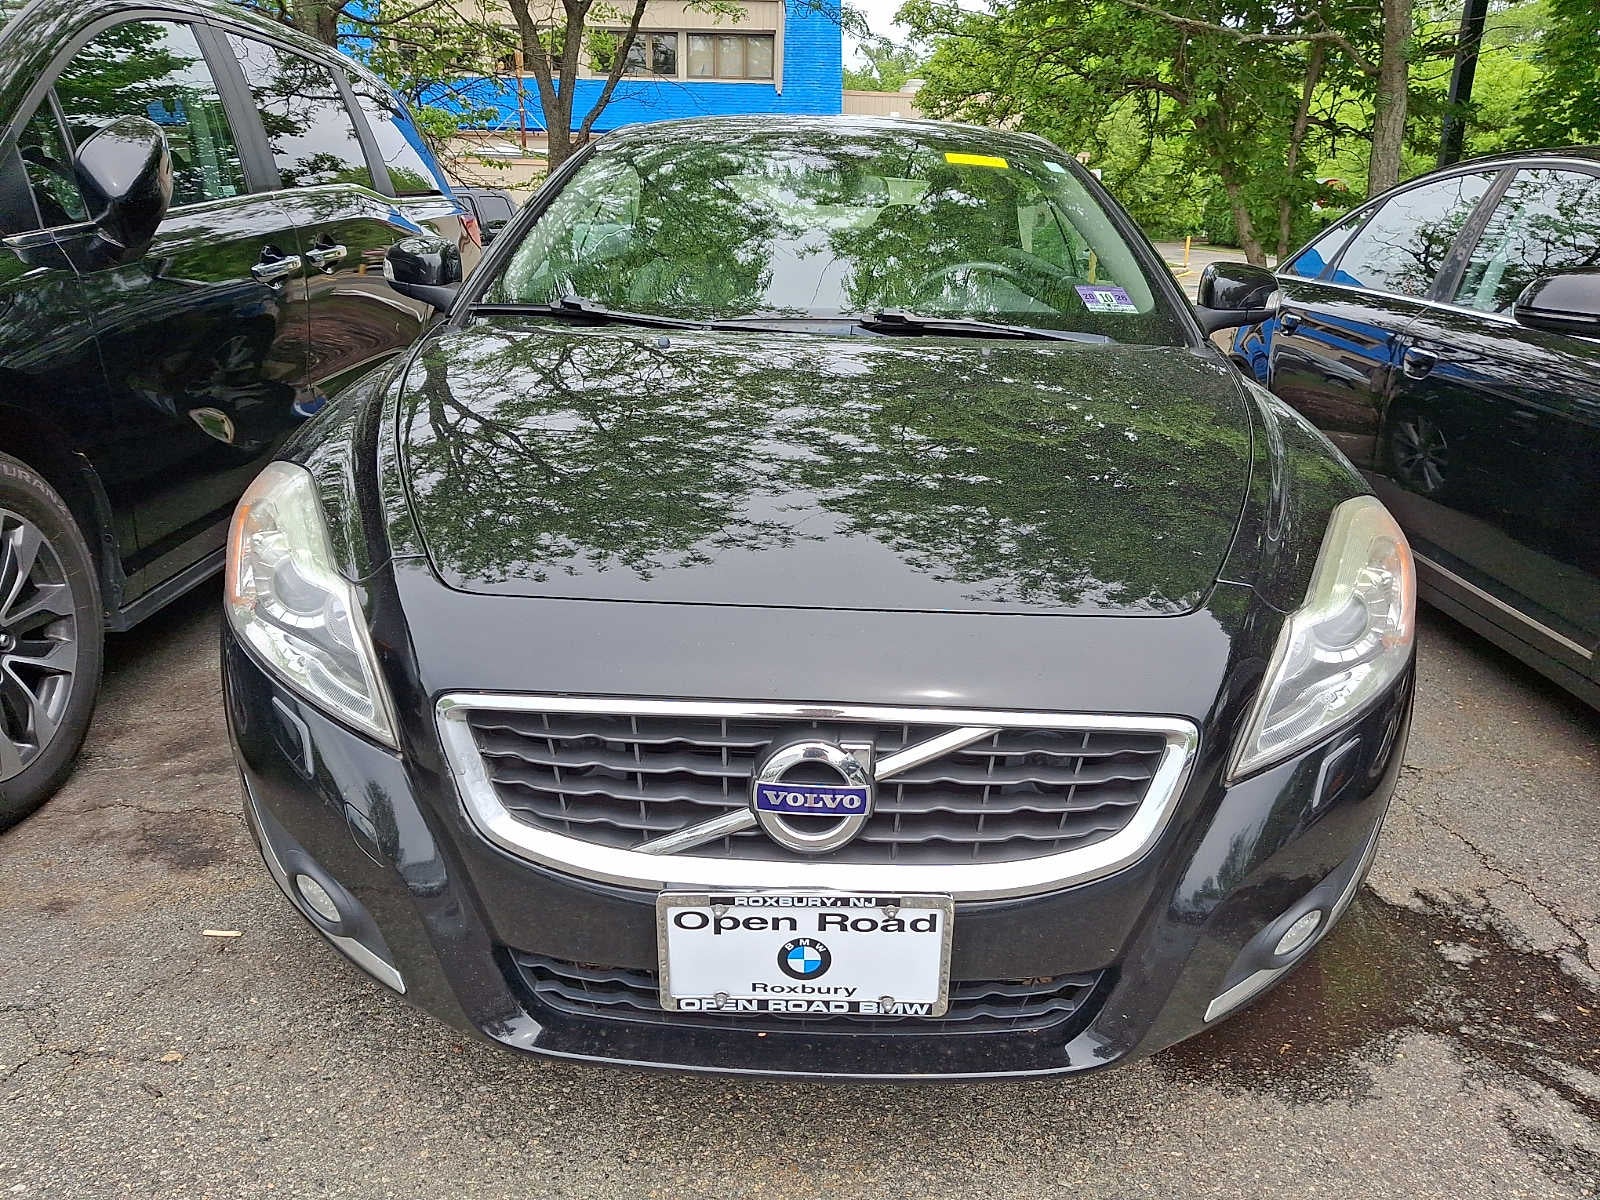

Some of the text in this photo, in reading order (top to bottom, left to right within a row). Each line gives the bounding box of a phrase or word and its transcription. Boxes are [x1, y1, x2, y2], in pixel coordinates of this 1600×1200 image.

[1099, 293, 1114, 302] 10
[763, 790, 862, 809] VOLVO
[734, 896, 876, 908] ROXBURY, NJ
[673, 911, 937, 935] Open Road
[785, 938, 827, 951] BMW
[751, 982, 857, 997] Roxbury
[680, 999, 758, 1011] OPEN
[768, 1000, 849, 1013] ROAD
